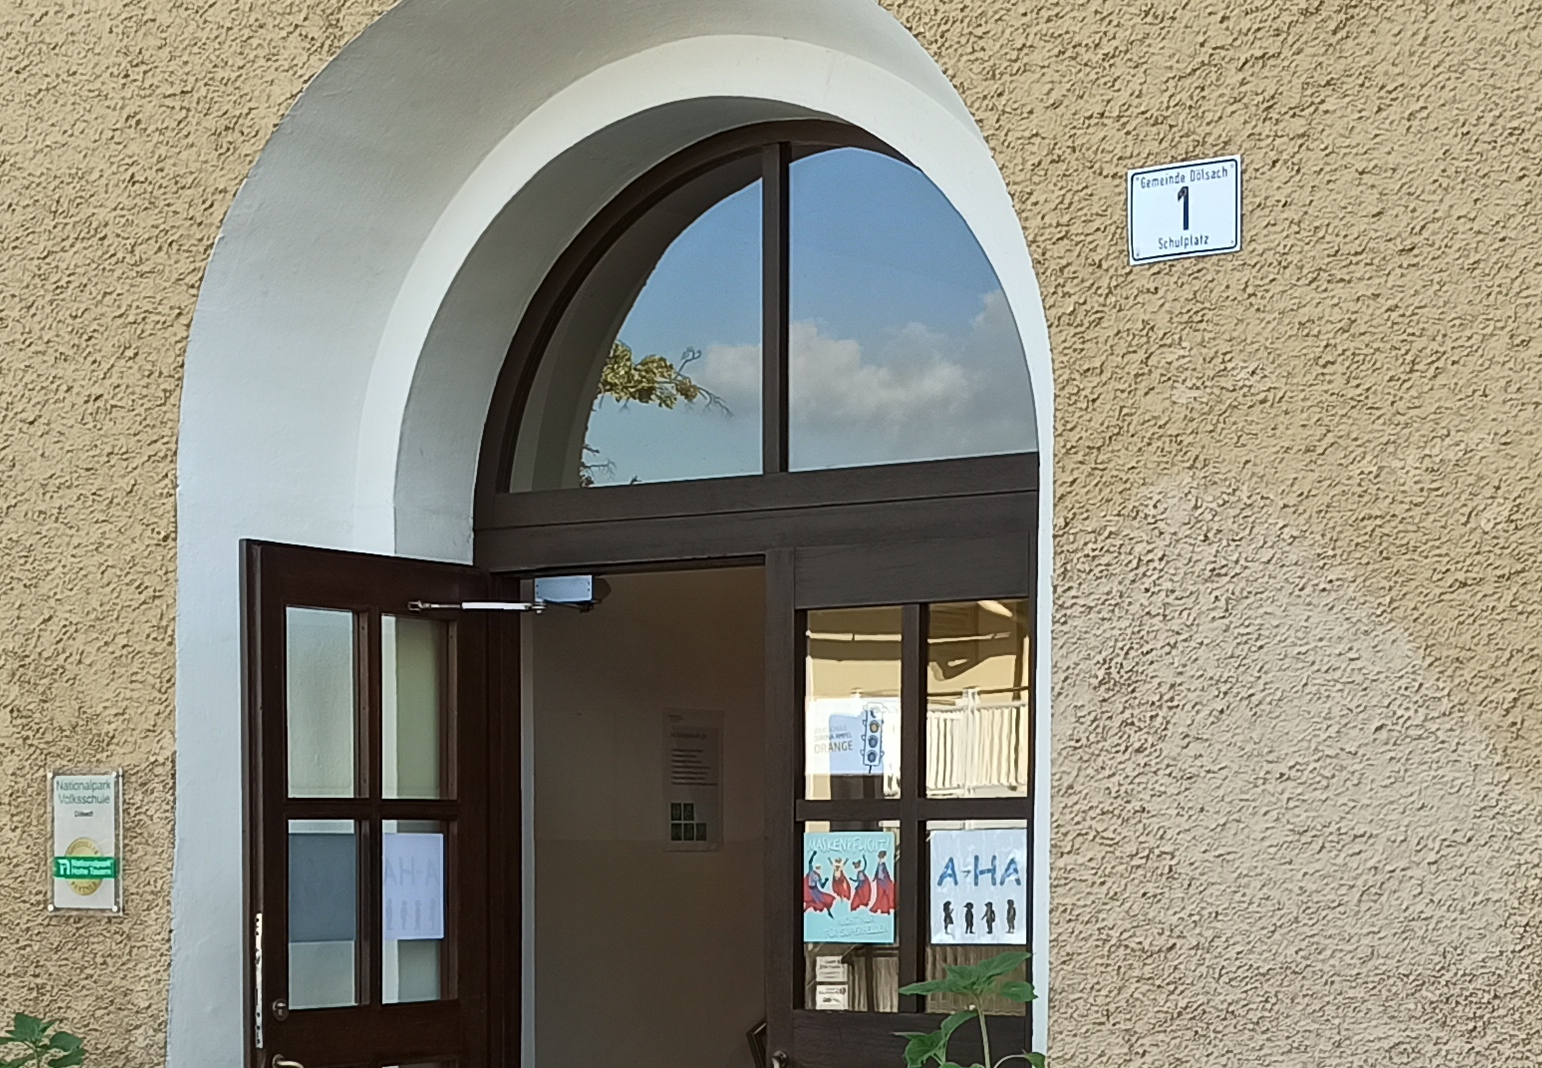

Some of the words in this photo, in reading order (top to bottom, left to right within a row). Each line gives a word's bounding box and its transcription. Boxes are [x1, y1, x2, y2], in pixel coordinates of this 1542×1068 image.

[1141, 172, 1185, 188] Gemeinde
[1190, 166, 1228, 182] Dölsach
[1177, 186, 1189, 231] 1
[1158, 235, 1209, 249] Schulplatz
[813, 740, 854, 754] ORANGE
[56, 780, 111, 792] Nationalpark
[58, 793, 111, 805] Volksschule
